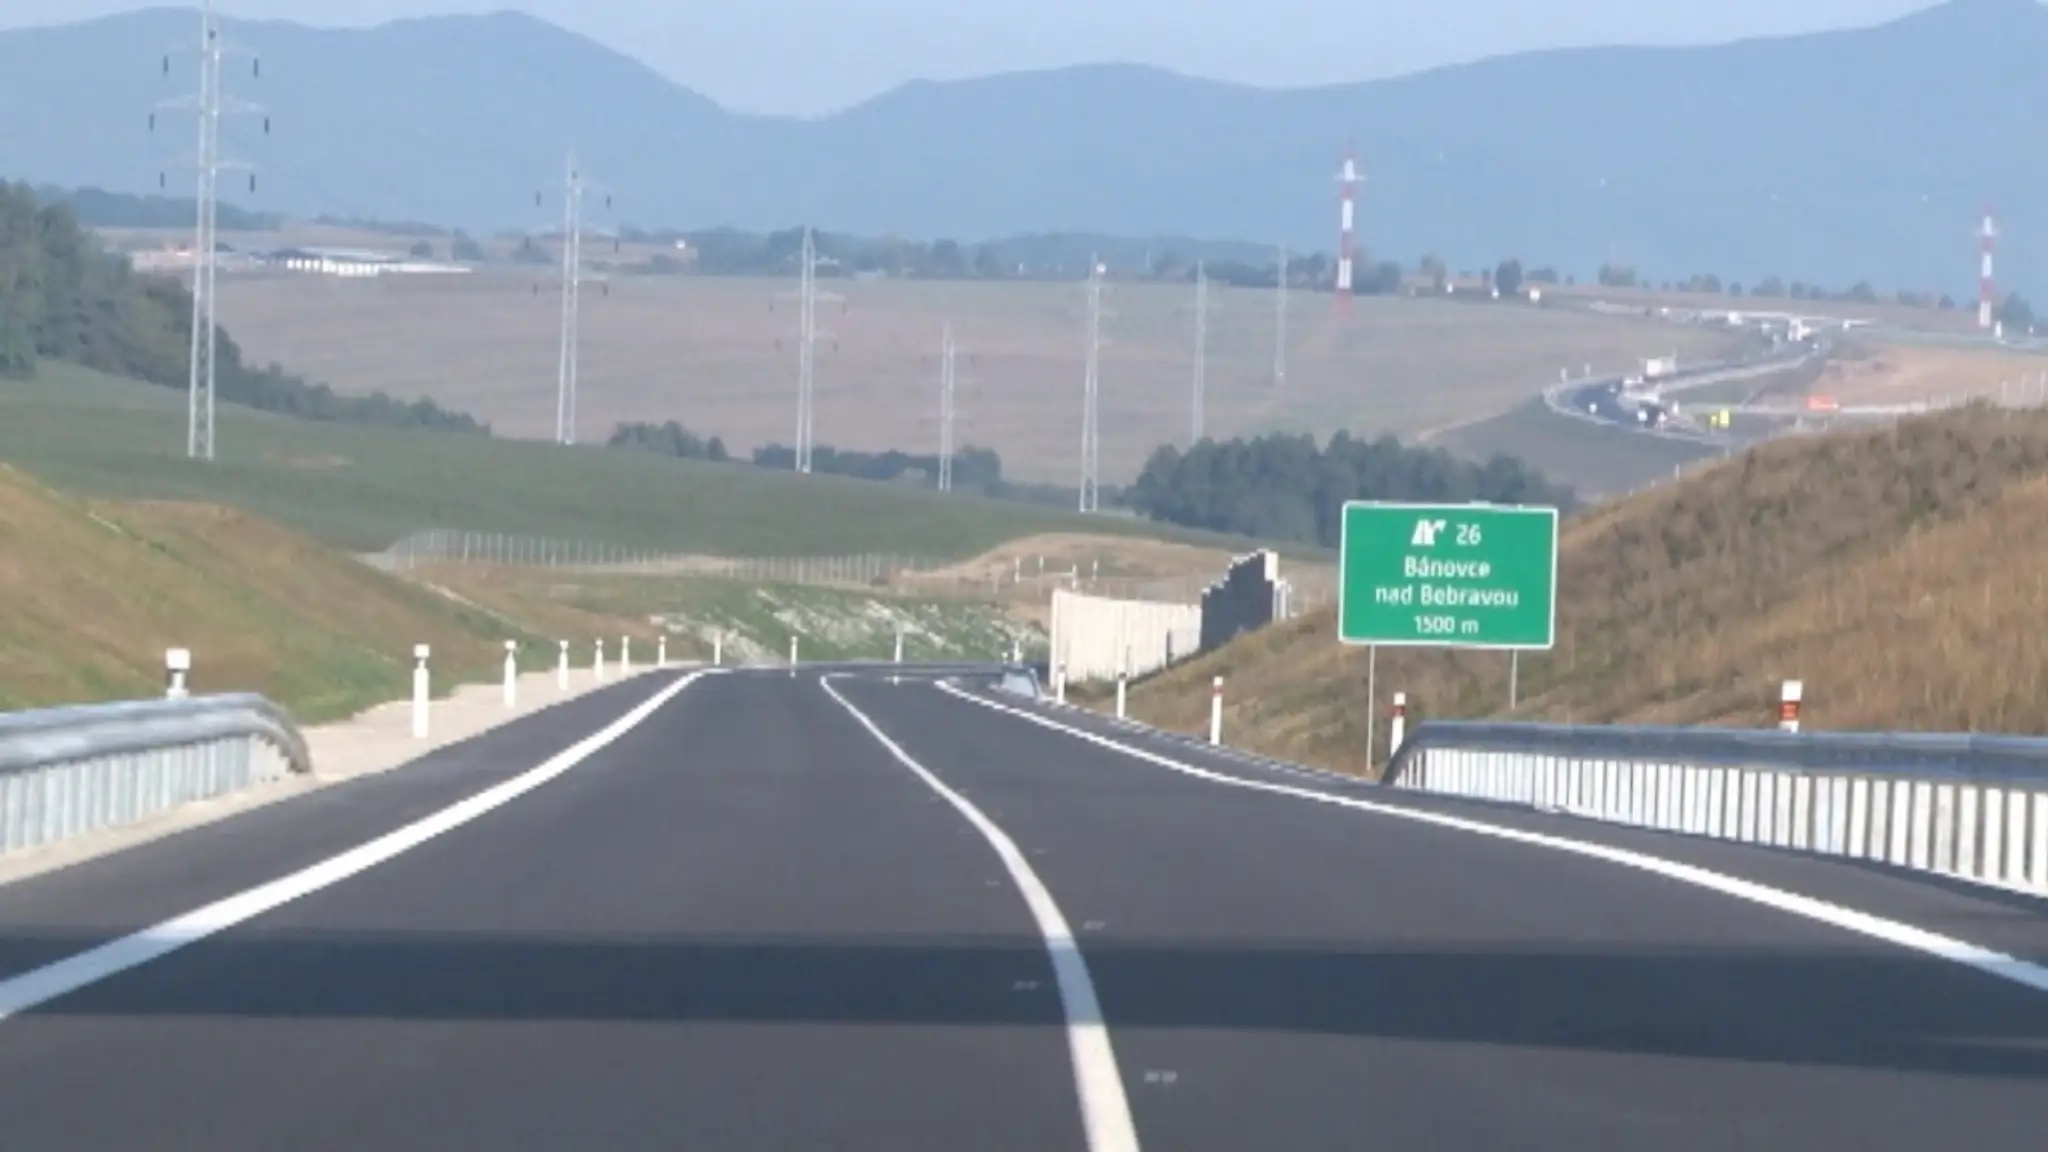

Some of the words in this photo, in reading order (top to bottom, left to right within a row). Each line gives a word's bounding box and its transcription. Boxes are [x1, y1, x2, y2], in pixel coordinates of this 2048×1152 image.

[1455, 524, 1481, 545] 26
[1404, 556, 1490, 577] Bánovce
[1376, 585, 1412, 605] nad
[1420, 584, 1518, 605] Bebravou
[1414, 616, 1455, 634] 1500
[1461, 620, 1479, 633] m
